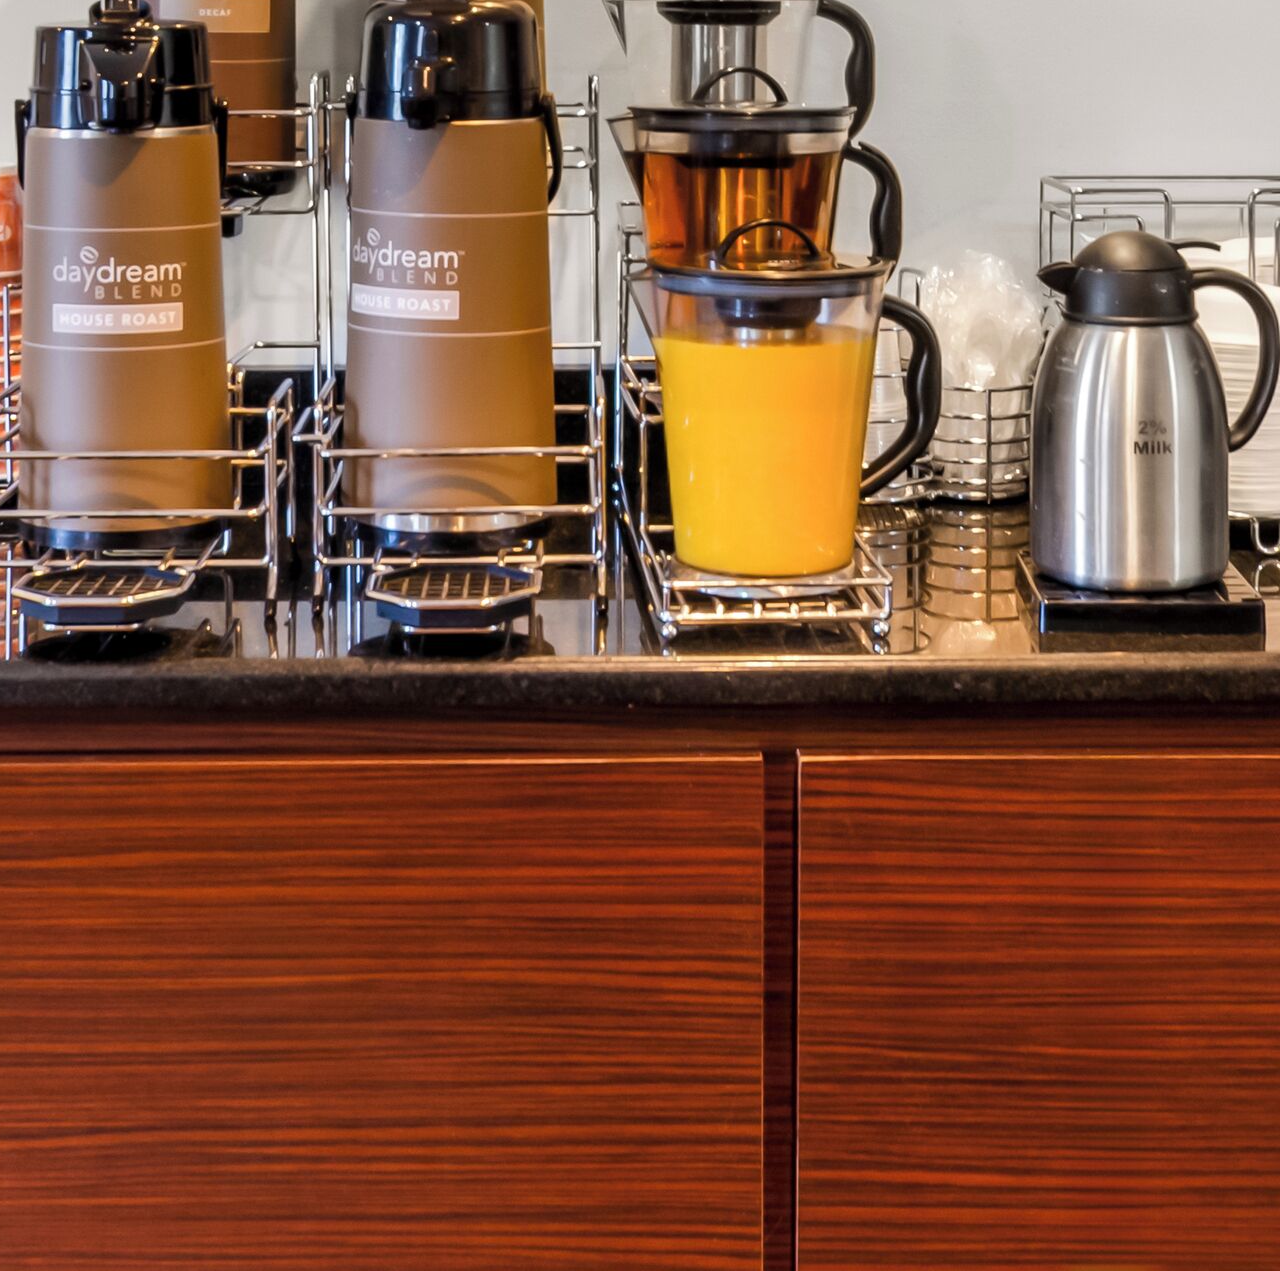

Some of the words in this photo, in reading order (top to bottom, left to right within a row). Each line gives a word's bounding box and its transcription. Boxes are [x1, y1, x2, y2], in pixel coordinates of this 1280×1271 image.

[376, 267, 459, 286] BLEND
[94, 283, 183, 301] BLEND
[354, 293, 391, 310] HOUSE
[397, 297, 452, 313] ROAST
[59, 313, 114, 327] HOUSE
[121, 311, 176, 327] ROAST
[1138, 419, 1168, 436] 2%
[1133, 439, 1173, 455] Milk
